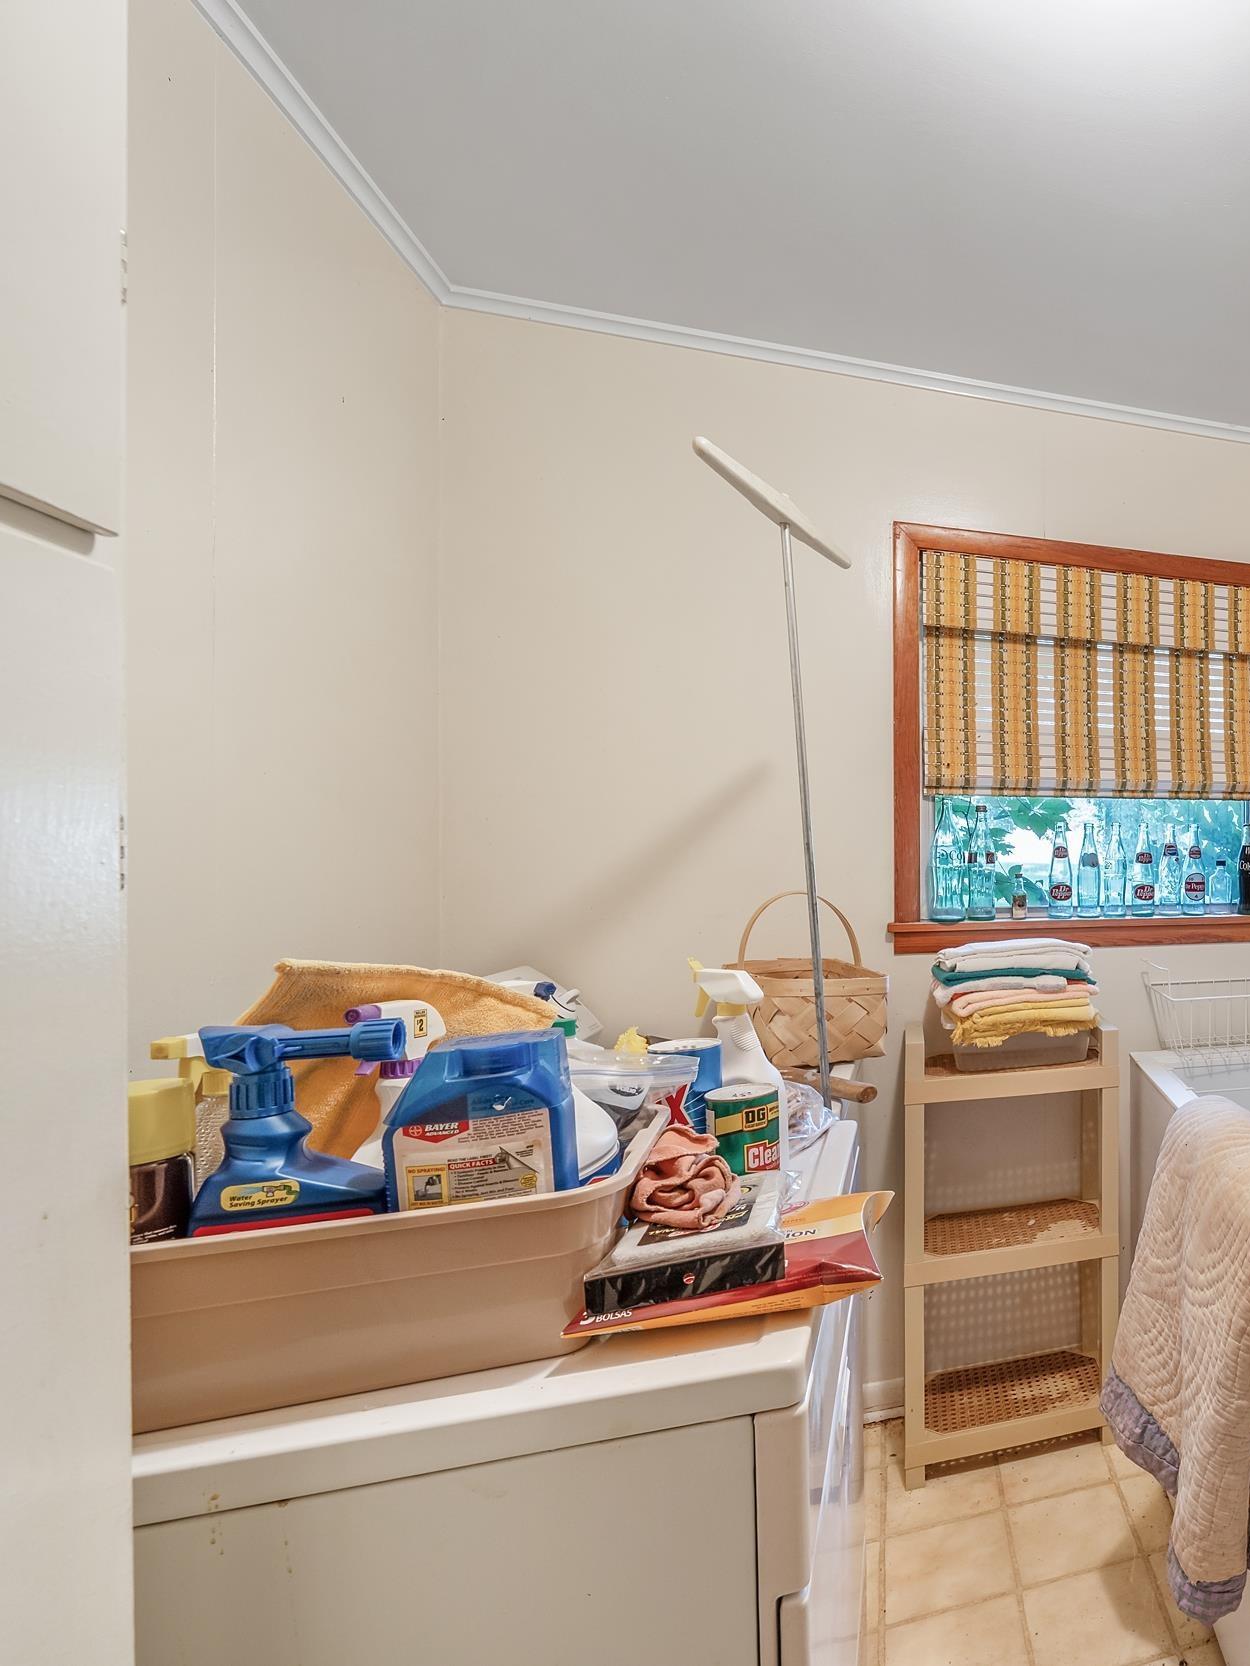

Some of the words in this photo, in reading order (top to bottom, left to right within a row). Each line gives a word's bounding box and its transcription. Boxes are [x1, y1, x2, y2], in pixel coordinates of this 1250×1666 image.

[1144, 885, 1154, 893] Dr
[745, 1107, 767, 1124] DG
[424, 1123, 459, 1132] BAYER
[749, 1145, 780, 1169] Clea
[450, 1162, 471, 1170] QUICK
[471, 1160, 494, 1168] FACTS
[257, 1196, 289, 1205] Sprayer
[595, 1309, 633, 1324] BOLSAS
